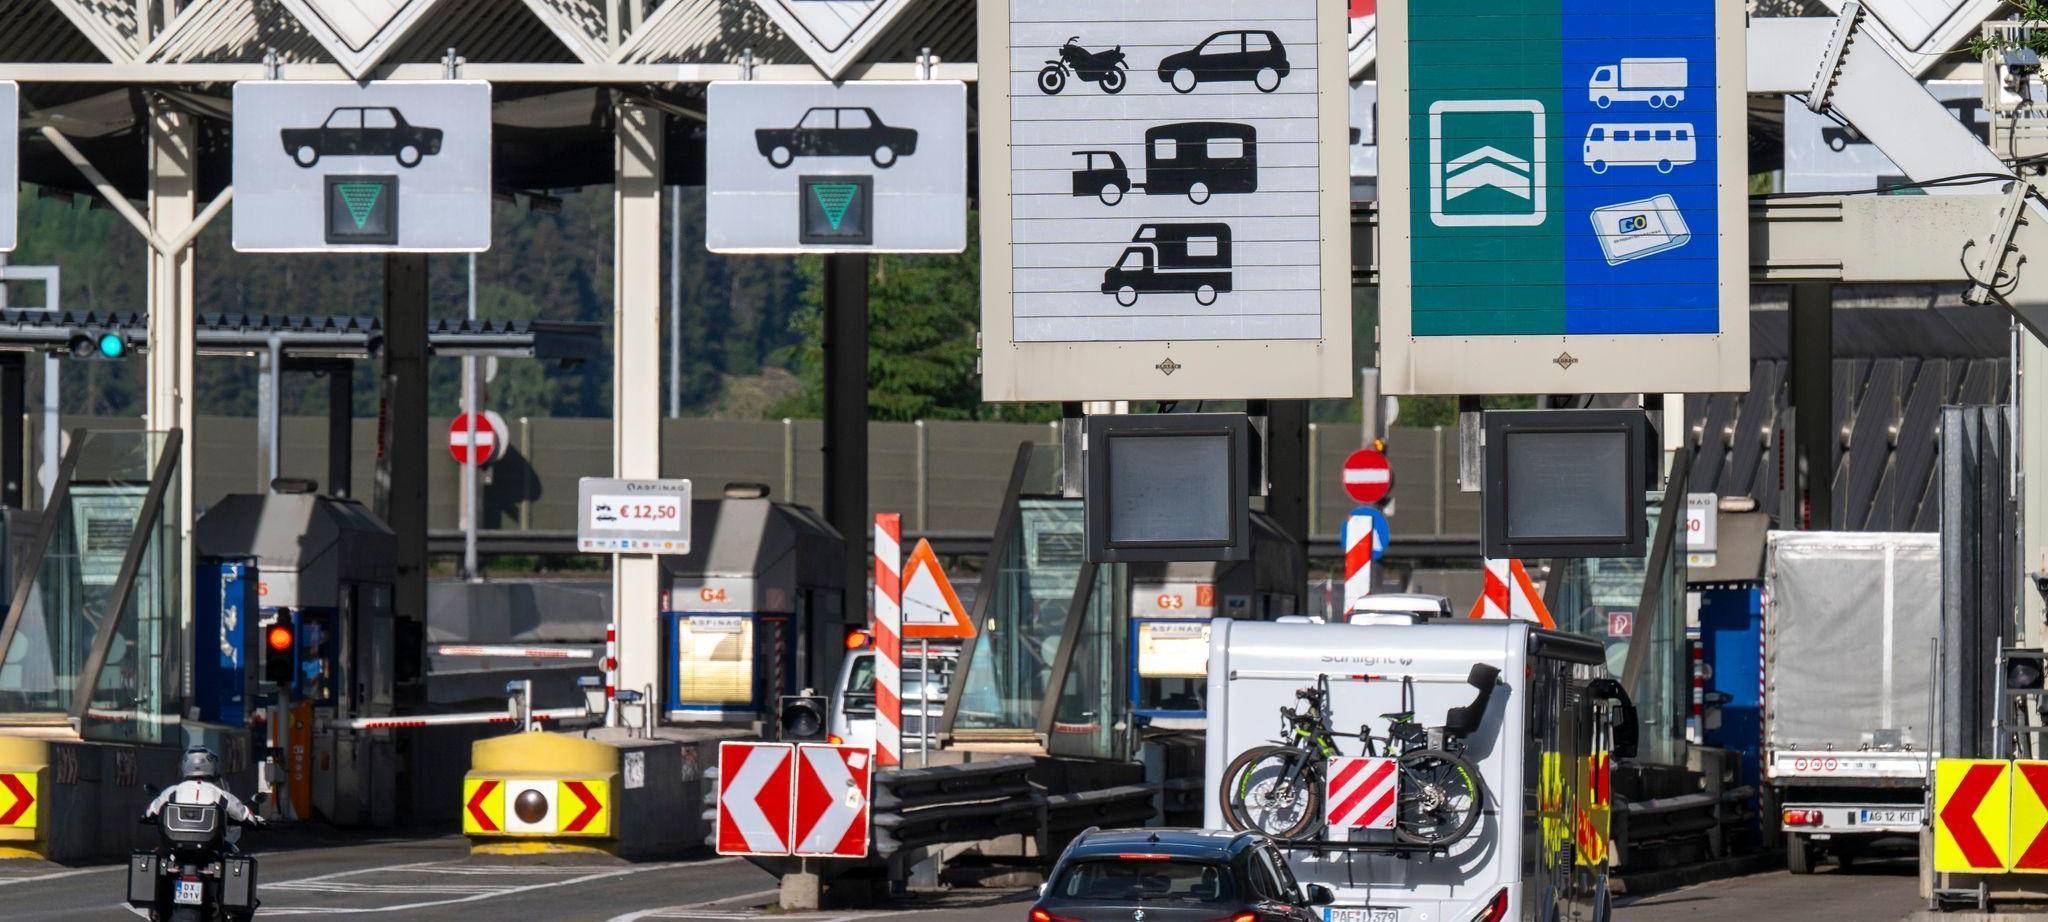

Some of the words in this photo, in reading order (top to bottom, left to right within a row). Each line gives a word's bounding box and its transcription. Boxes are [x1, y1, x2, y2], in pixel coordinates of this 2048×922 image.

[1620, 216, 1647, 233] GO
[620, 505, 629, 518] €
[634, 505, 676, 520] 12,50
[701, 588, 727, 602] G4
[1157, 594, 1183, 609] G3
